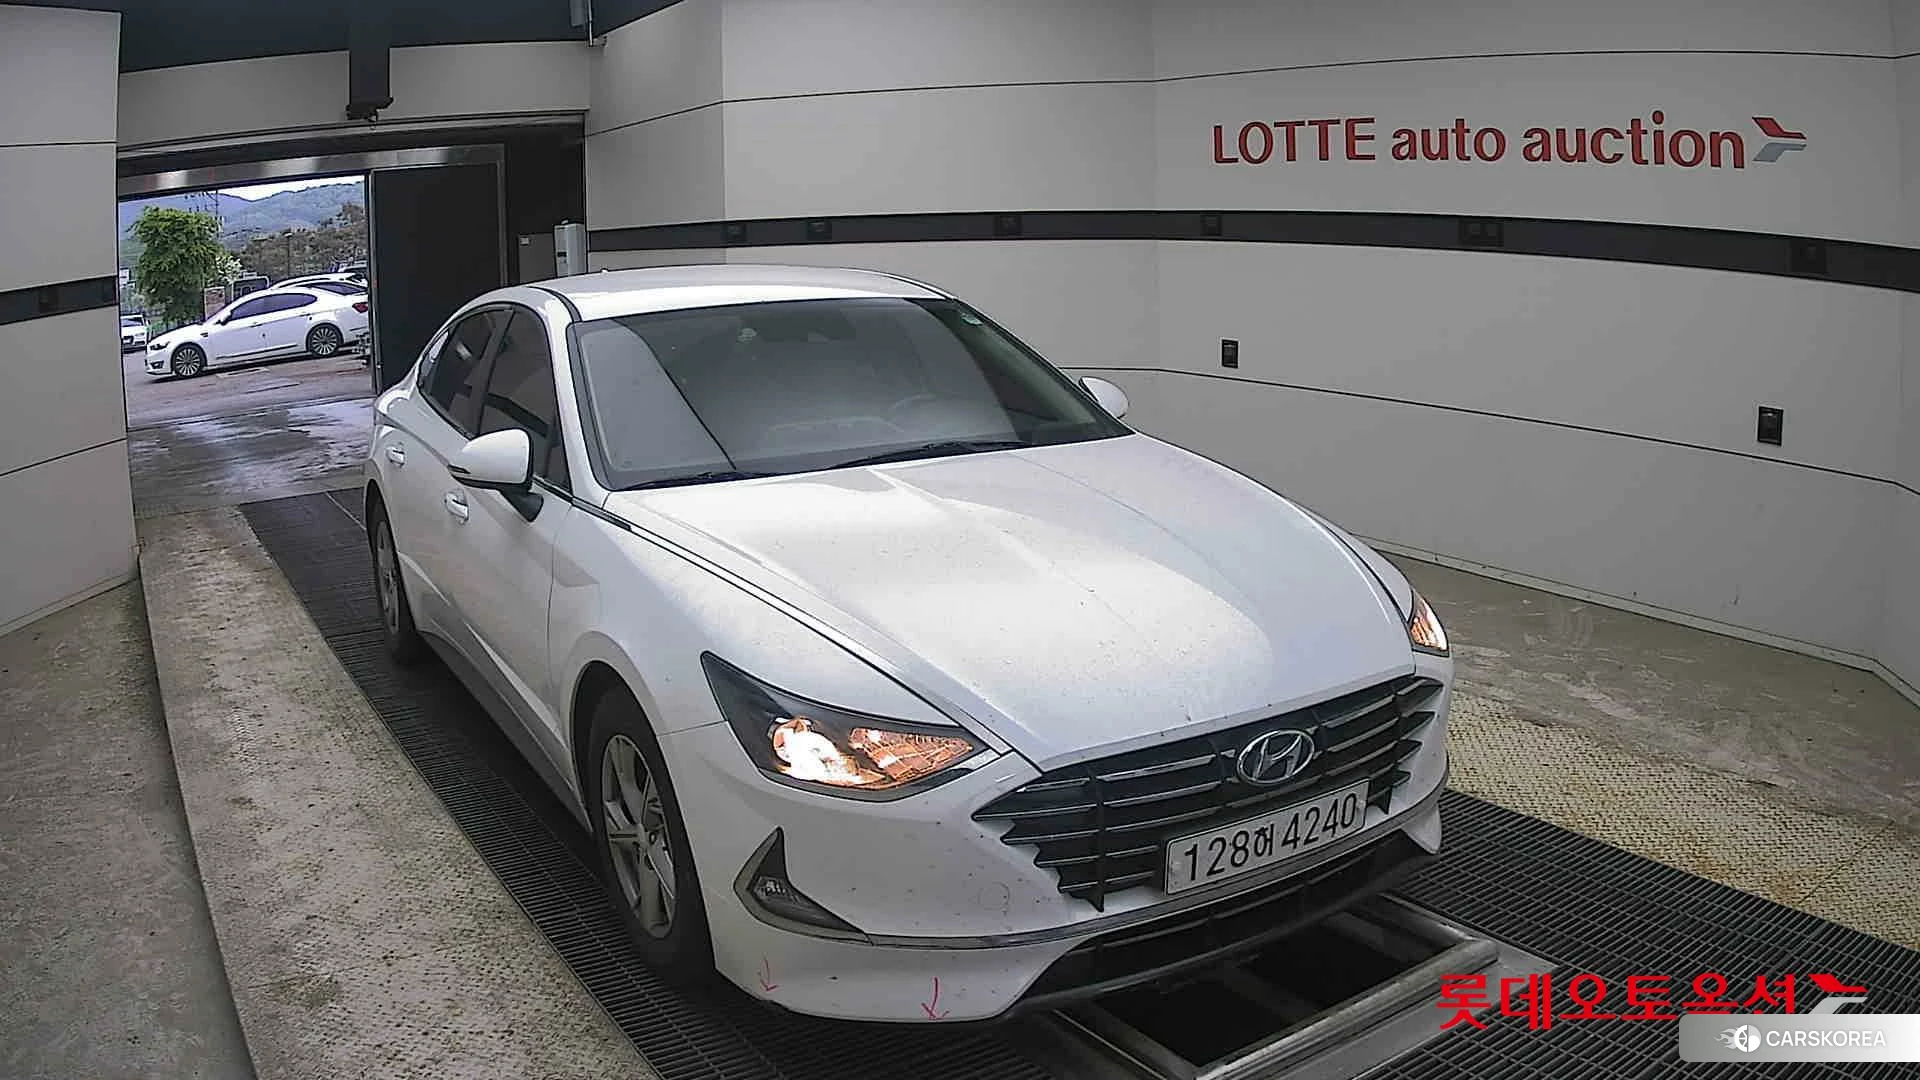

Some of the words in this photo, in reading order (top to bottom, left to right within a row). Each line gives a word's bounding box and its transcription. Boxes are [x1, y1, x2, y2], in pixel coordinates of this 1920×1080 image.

[1213, 117, 1377, 165] LOTTE
[1392, 118, 1505, 162] auto
[1523, 110, 1746, 169] auction
[1281, 793, 1357, 850] 4240
